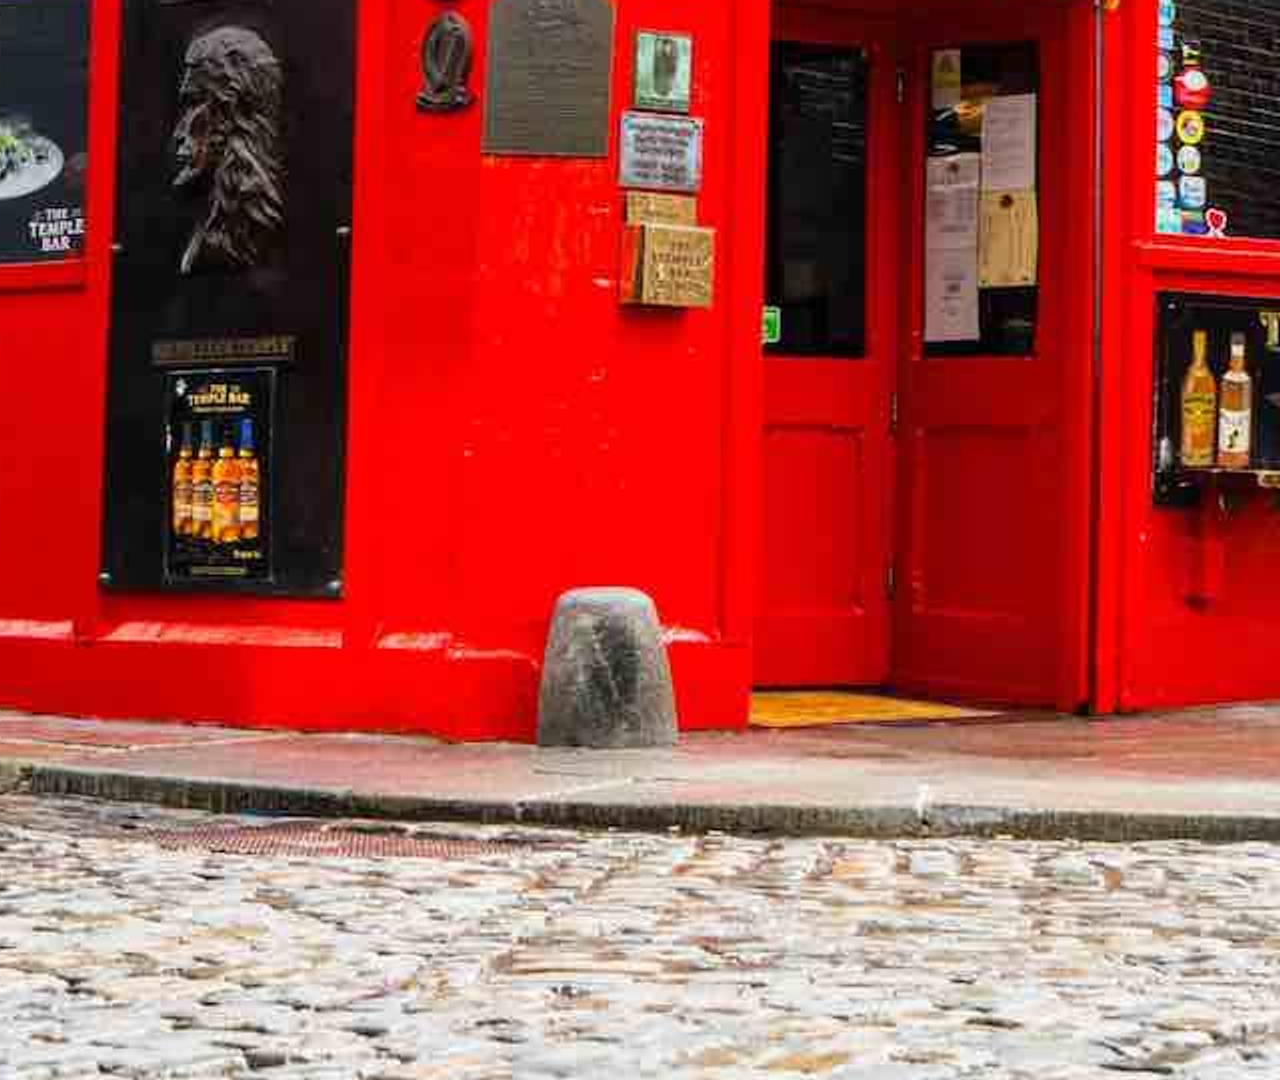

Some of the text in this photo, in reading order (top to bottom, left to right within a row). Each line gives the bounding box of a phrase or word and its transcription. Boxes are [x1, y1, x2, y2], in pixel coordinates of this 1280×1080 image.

[46, 207, 68, 220] THE
[28, 217, 85, 238] TEMPLE
[41, 235, 71, 252] BAR
